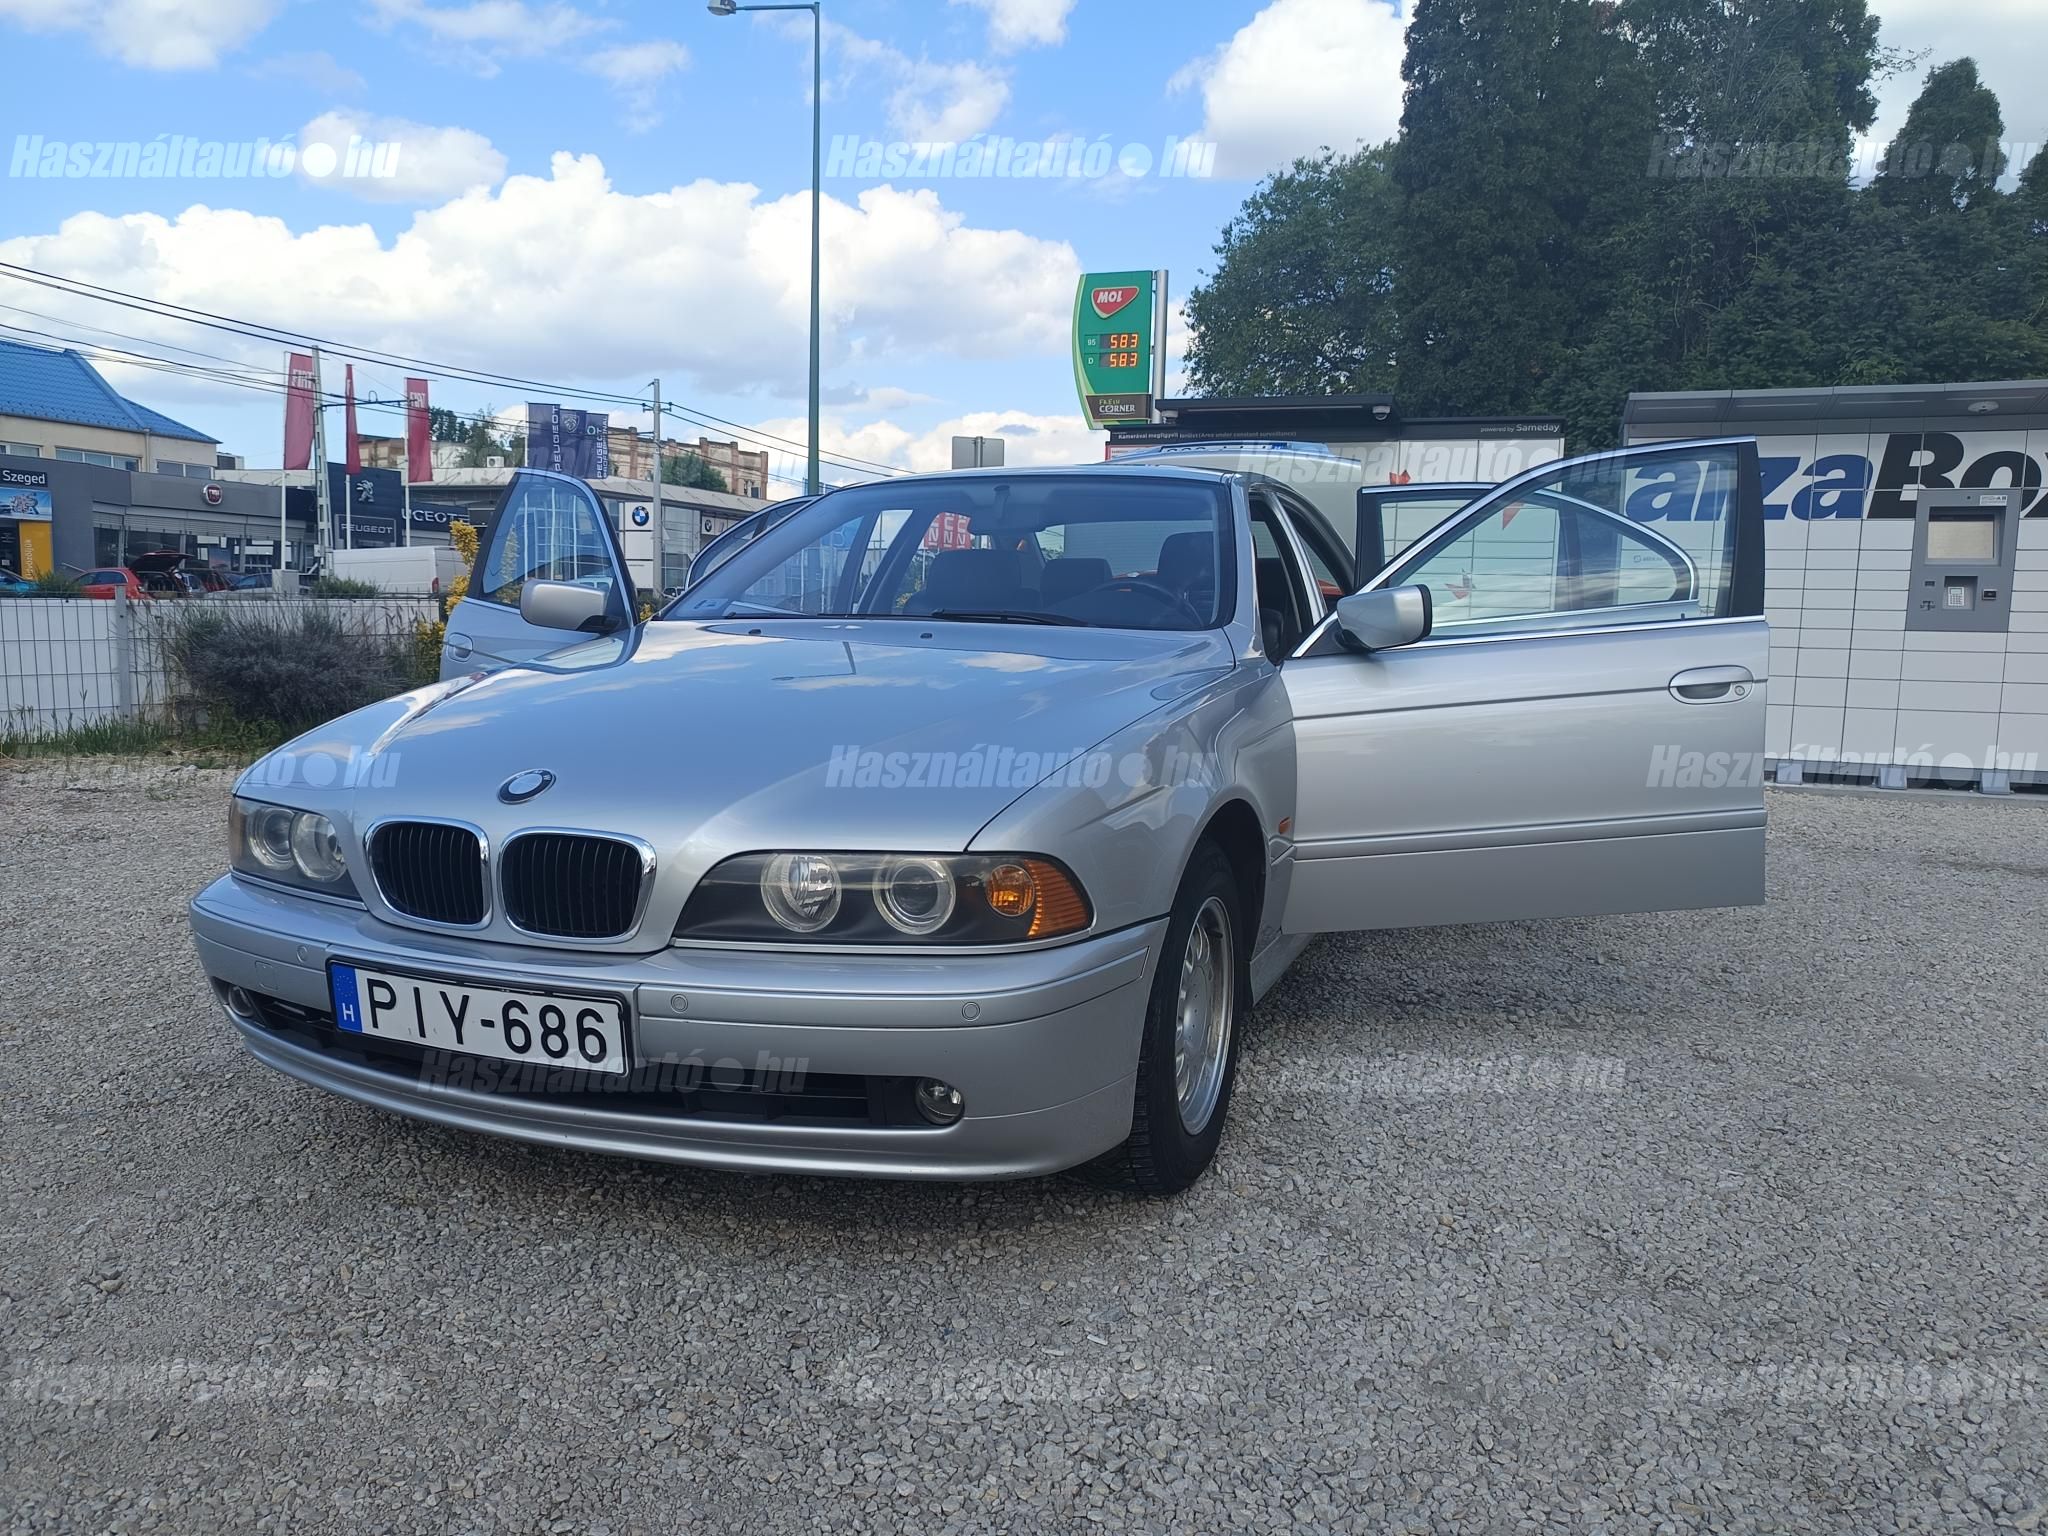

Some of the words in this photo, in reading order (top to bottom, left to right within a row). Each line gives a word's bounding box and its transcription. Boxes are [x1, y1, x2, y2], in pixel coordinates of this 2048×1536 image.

[1097, 290, 1123, 304] MOL
[1110, 334, 1139, 349] 583
[1088, 357, 1094, 365] D
[1109, 353, 1138, 367] 583
[1099, 405, 1136, 413] CORNER
[1516, 423, 1560, 432] Sameday
[552, 405, 562, 472] PEUGEOT
[2, 470, 46, 485] Szeged
[341, 1002, 355, 1022] H
[366, 977, 607, 1064] PIY-686
